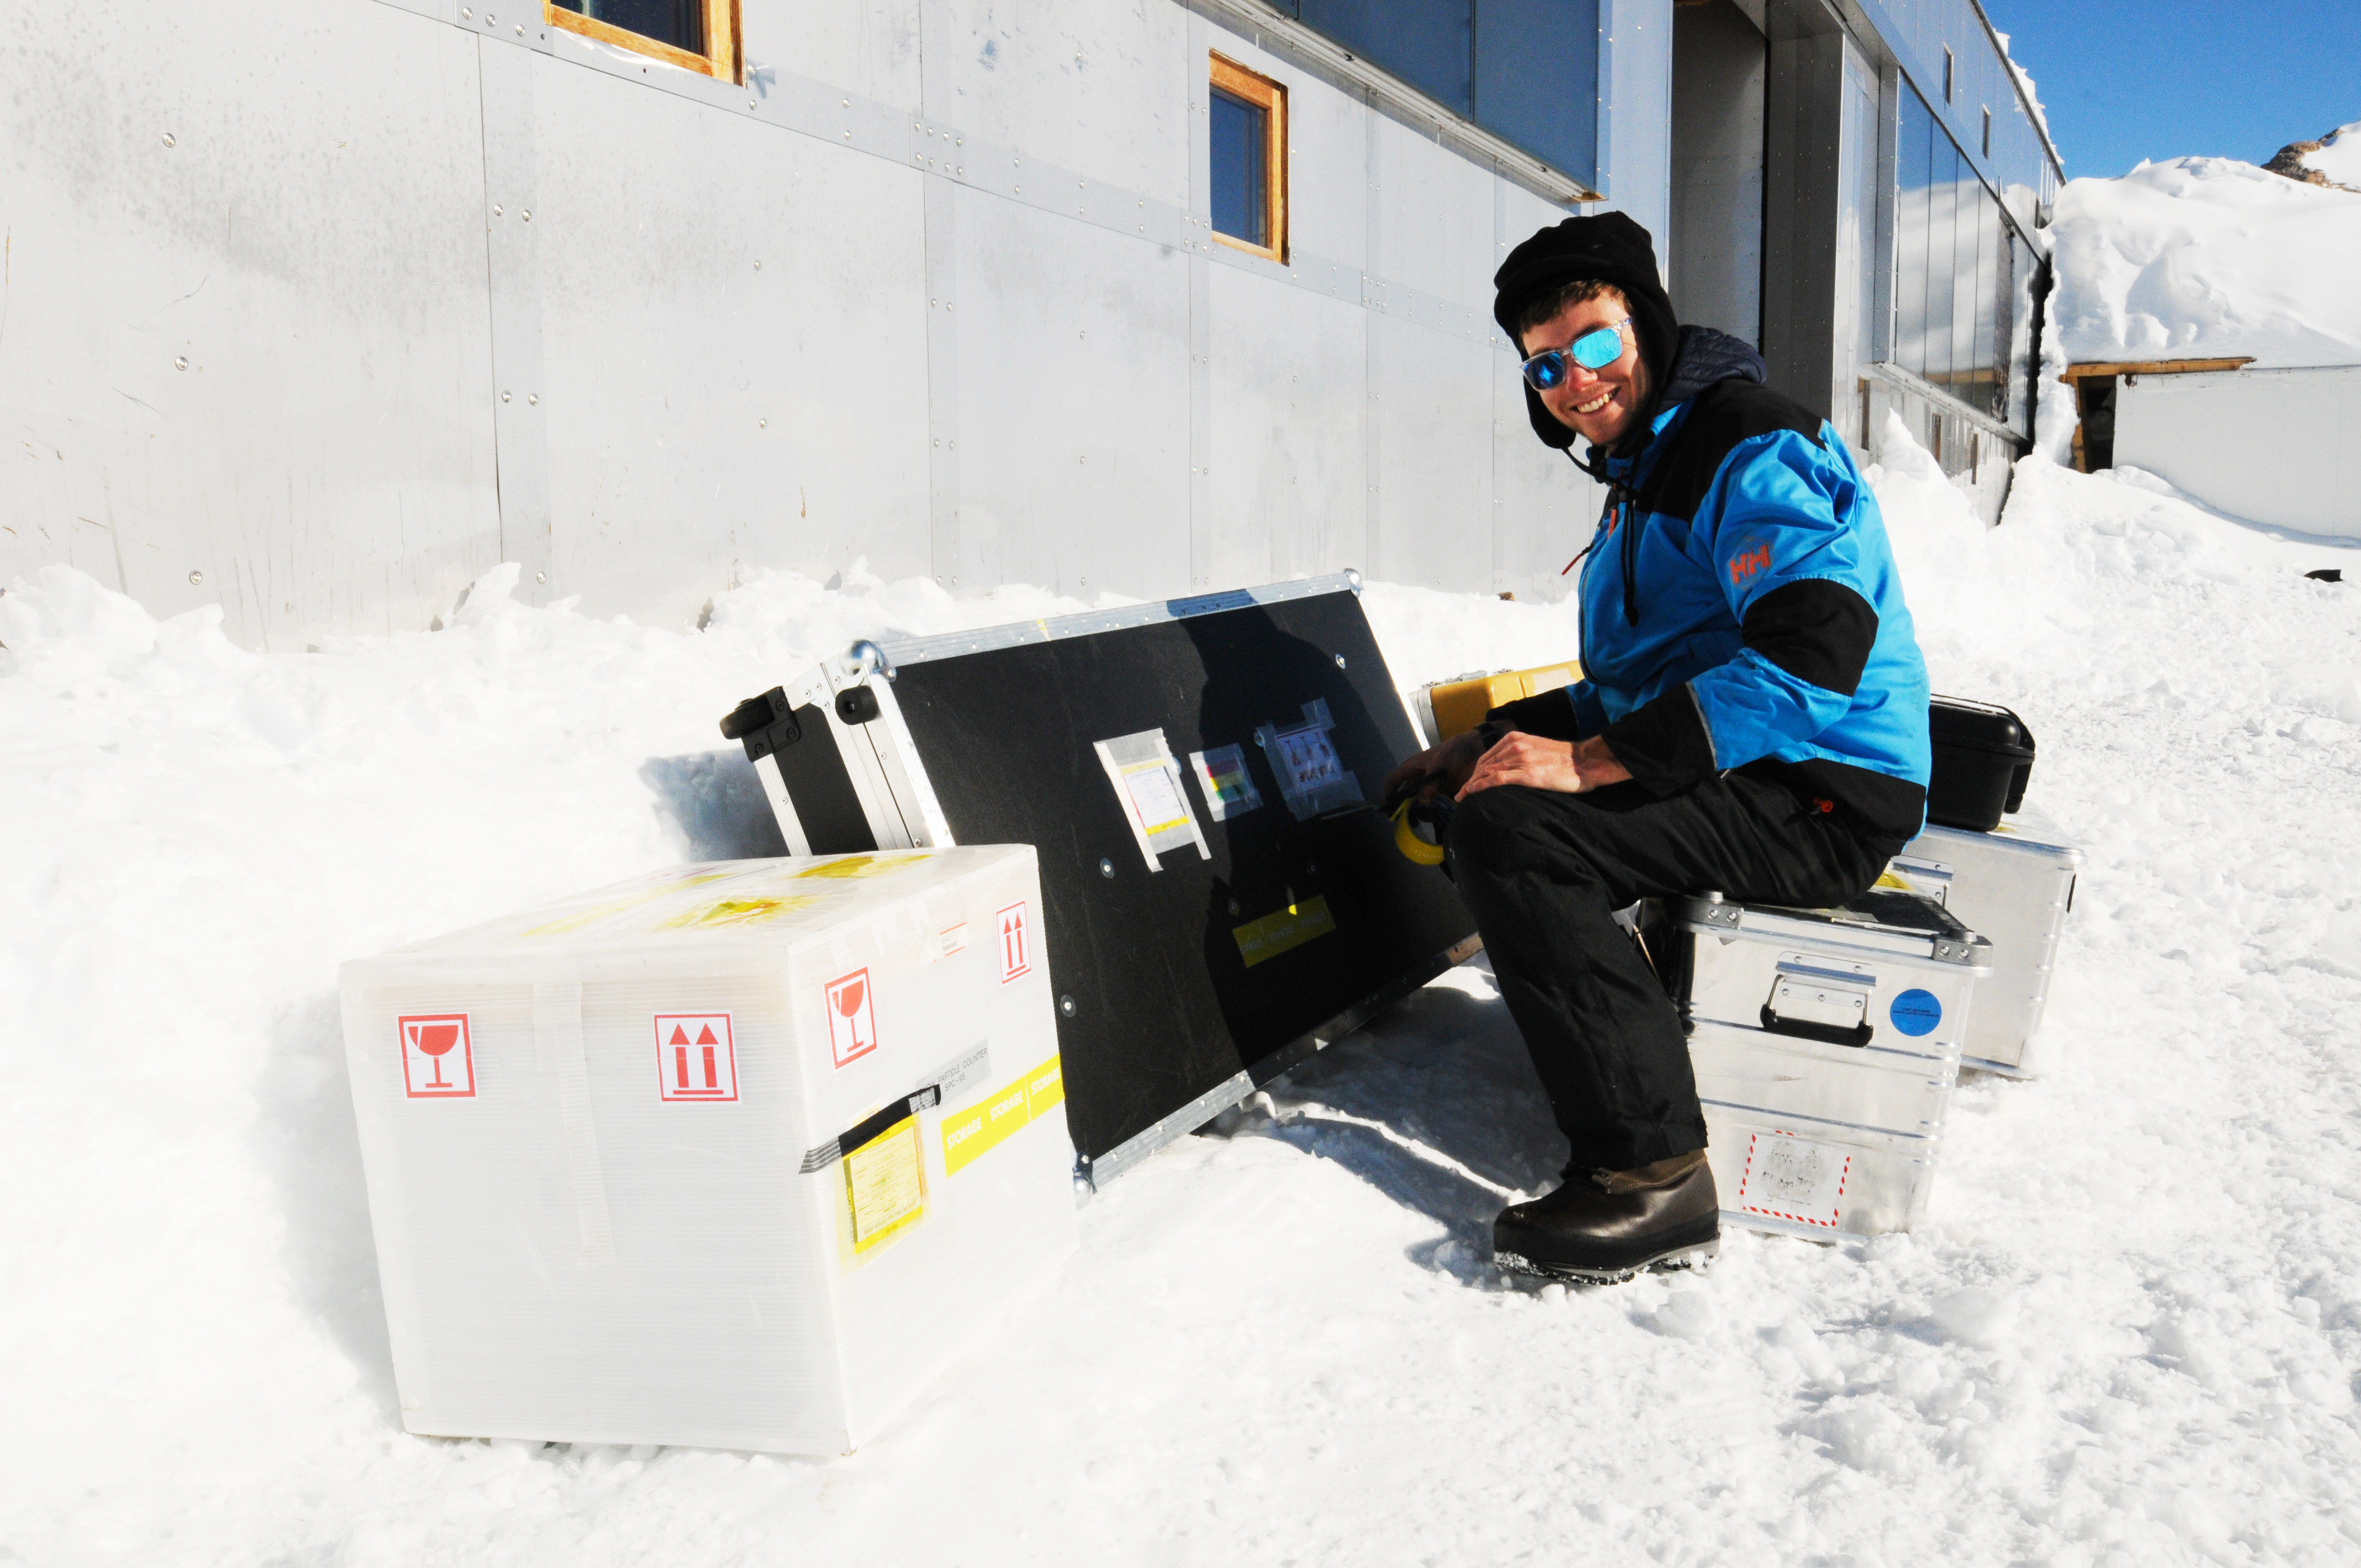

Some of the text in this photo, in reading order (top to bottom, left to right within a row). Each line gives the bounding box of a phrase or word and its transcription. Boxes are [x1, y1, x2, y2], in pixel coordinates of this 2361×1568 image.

[1729, 544, 1770, 584] HH
[938, 1064, 960, 1084] PARTICLE
[963, 1048, 988, 1069] COUNTER
[945, 1073, 966, 1092] SPC-95
[946, 1066, 1061, 1150] STORAGE STORAGE STORAGE
